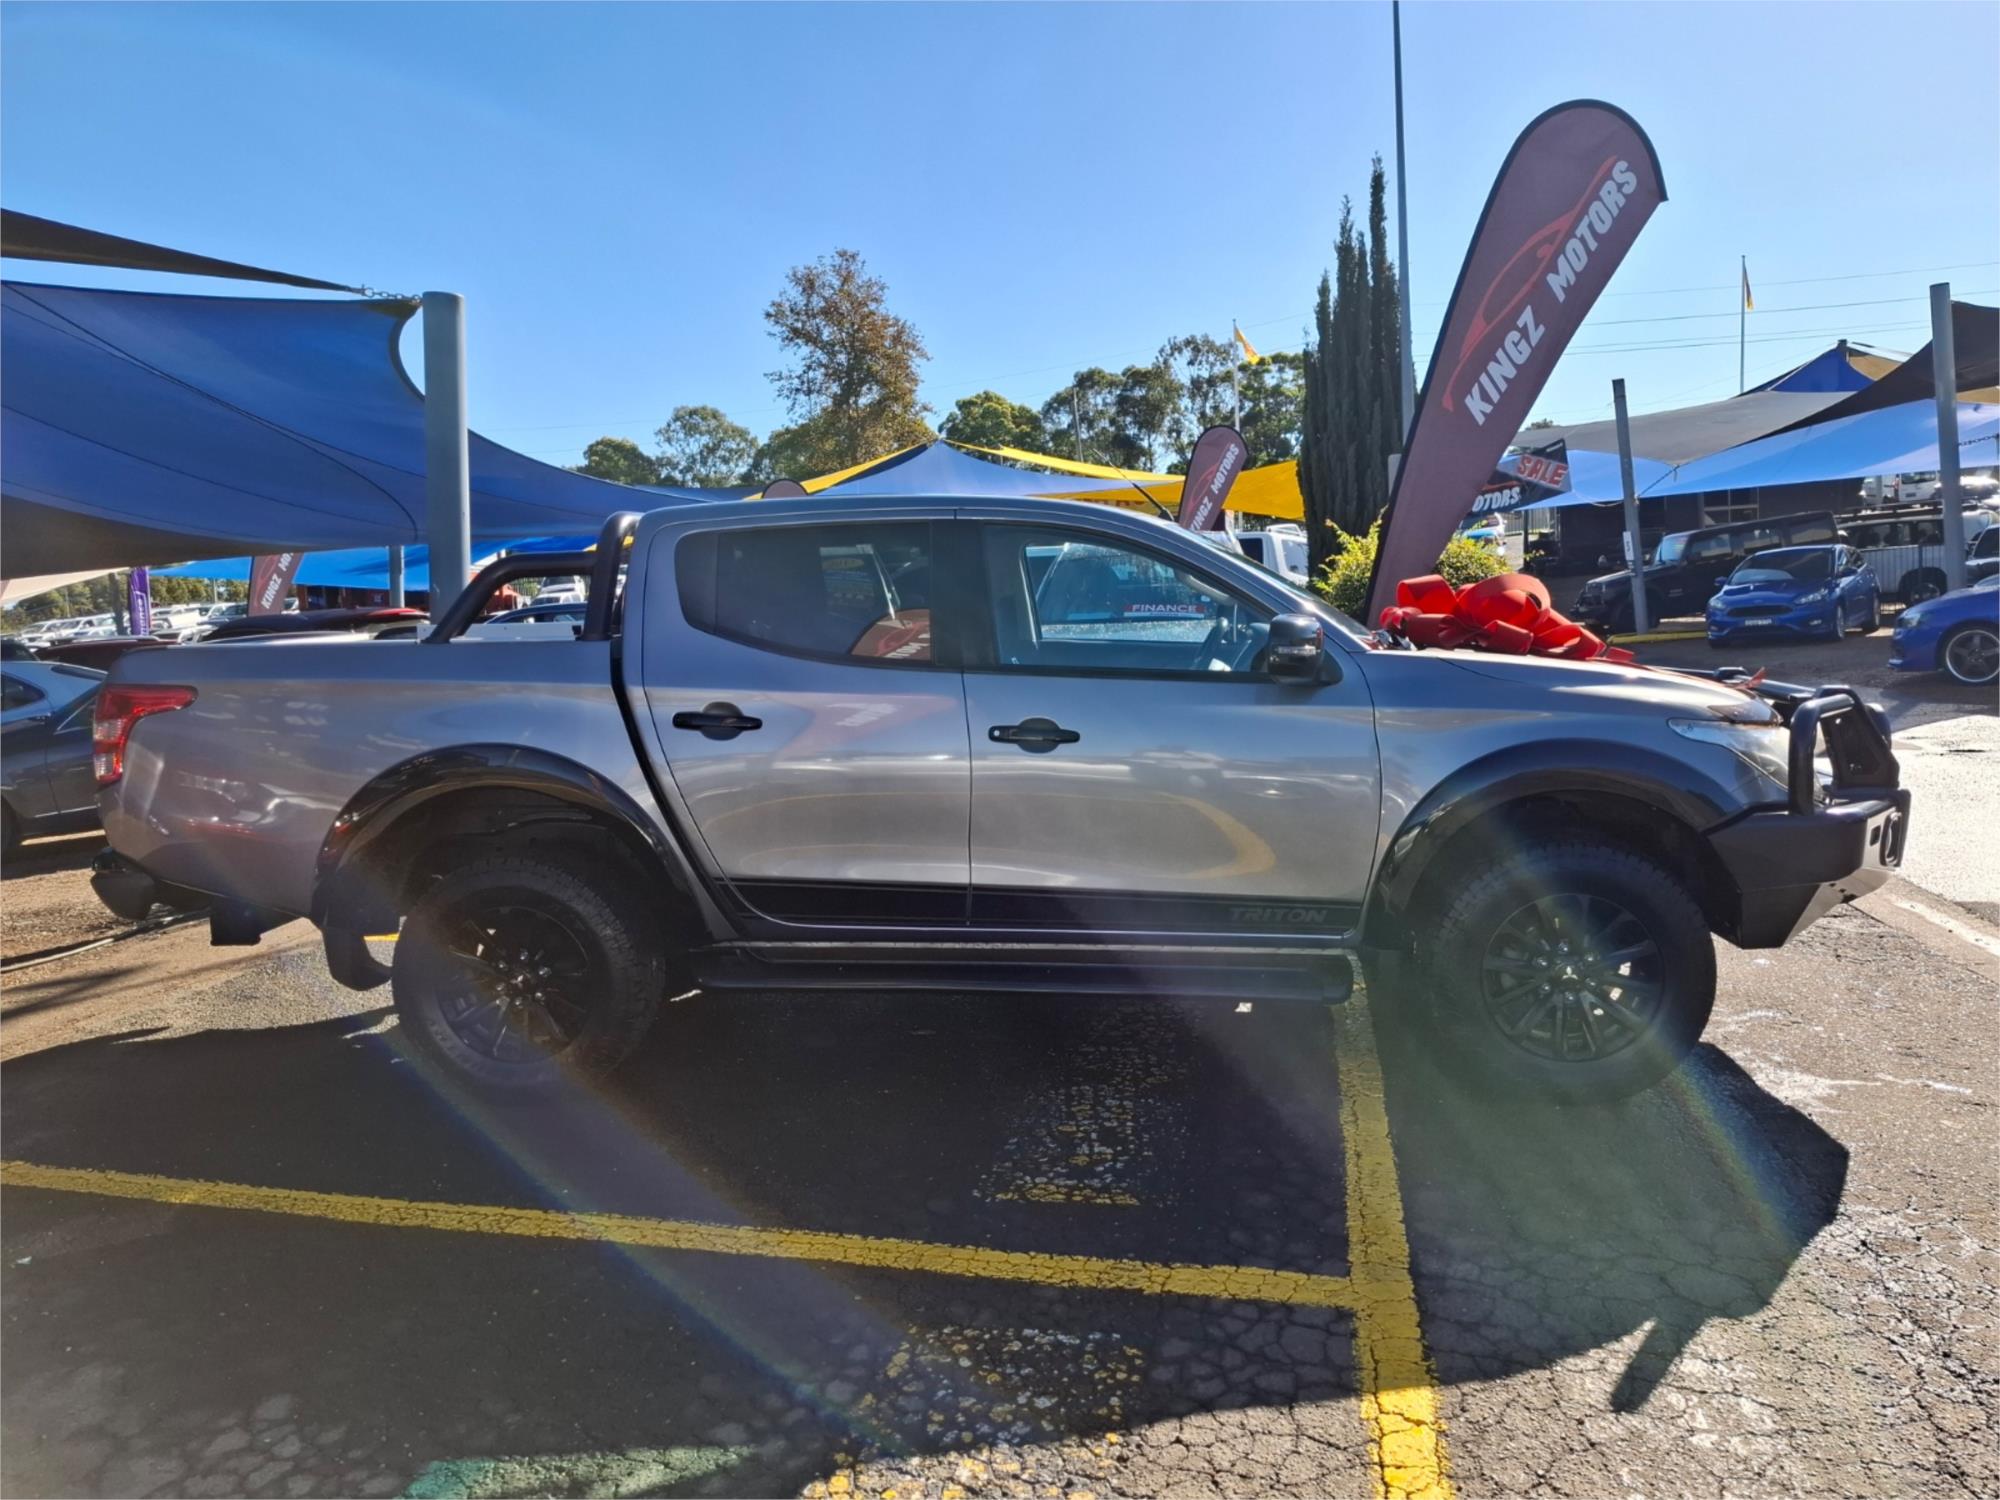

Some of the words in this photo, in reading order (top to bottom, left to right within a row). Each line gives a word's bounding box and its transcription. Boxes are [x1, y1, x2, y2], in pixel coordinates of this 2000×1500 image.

[1464, 305, 1545, 426] KINGZ
[1546, 160, 1637, 303] MOTORS
[1210, 443, 1240, 495] MOTORS
[1517, 454, 1568, 488] SALE
[260, 573, 283, 610] KINGZ
[277, 552, 295, 572] MO
[1131, 604, 1197, 613] FINANCE
[1229, 906, 1329, 923] TRITON
